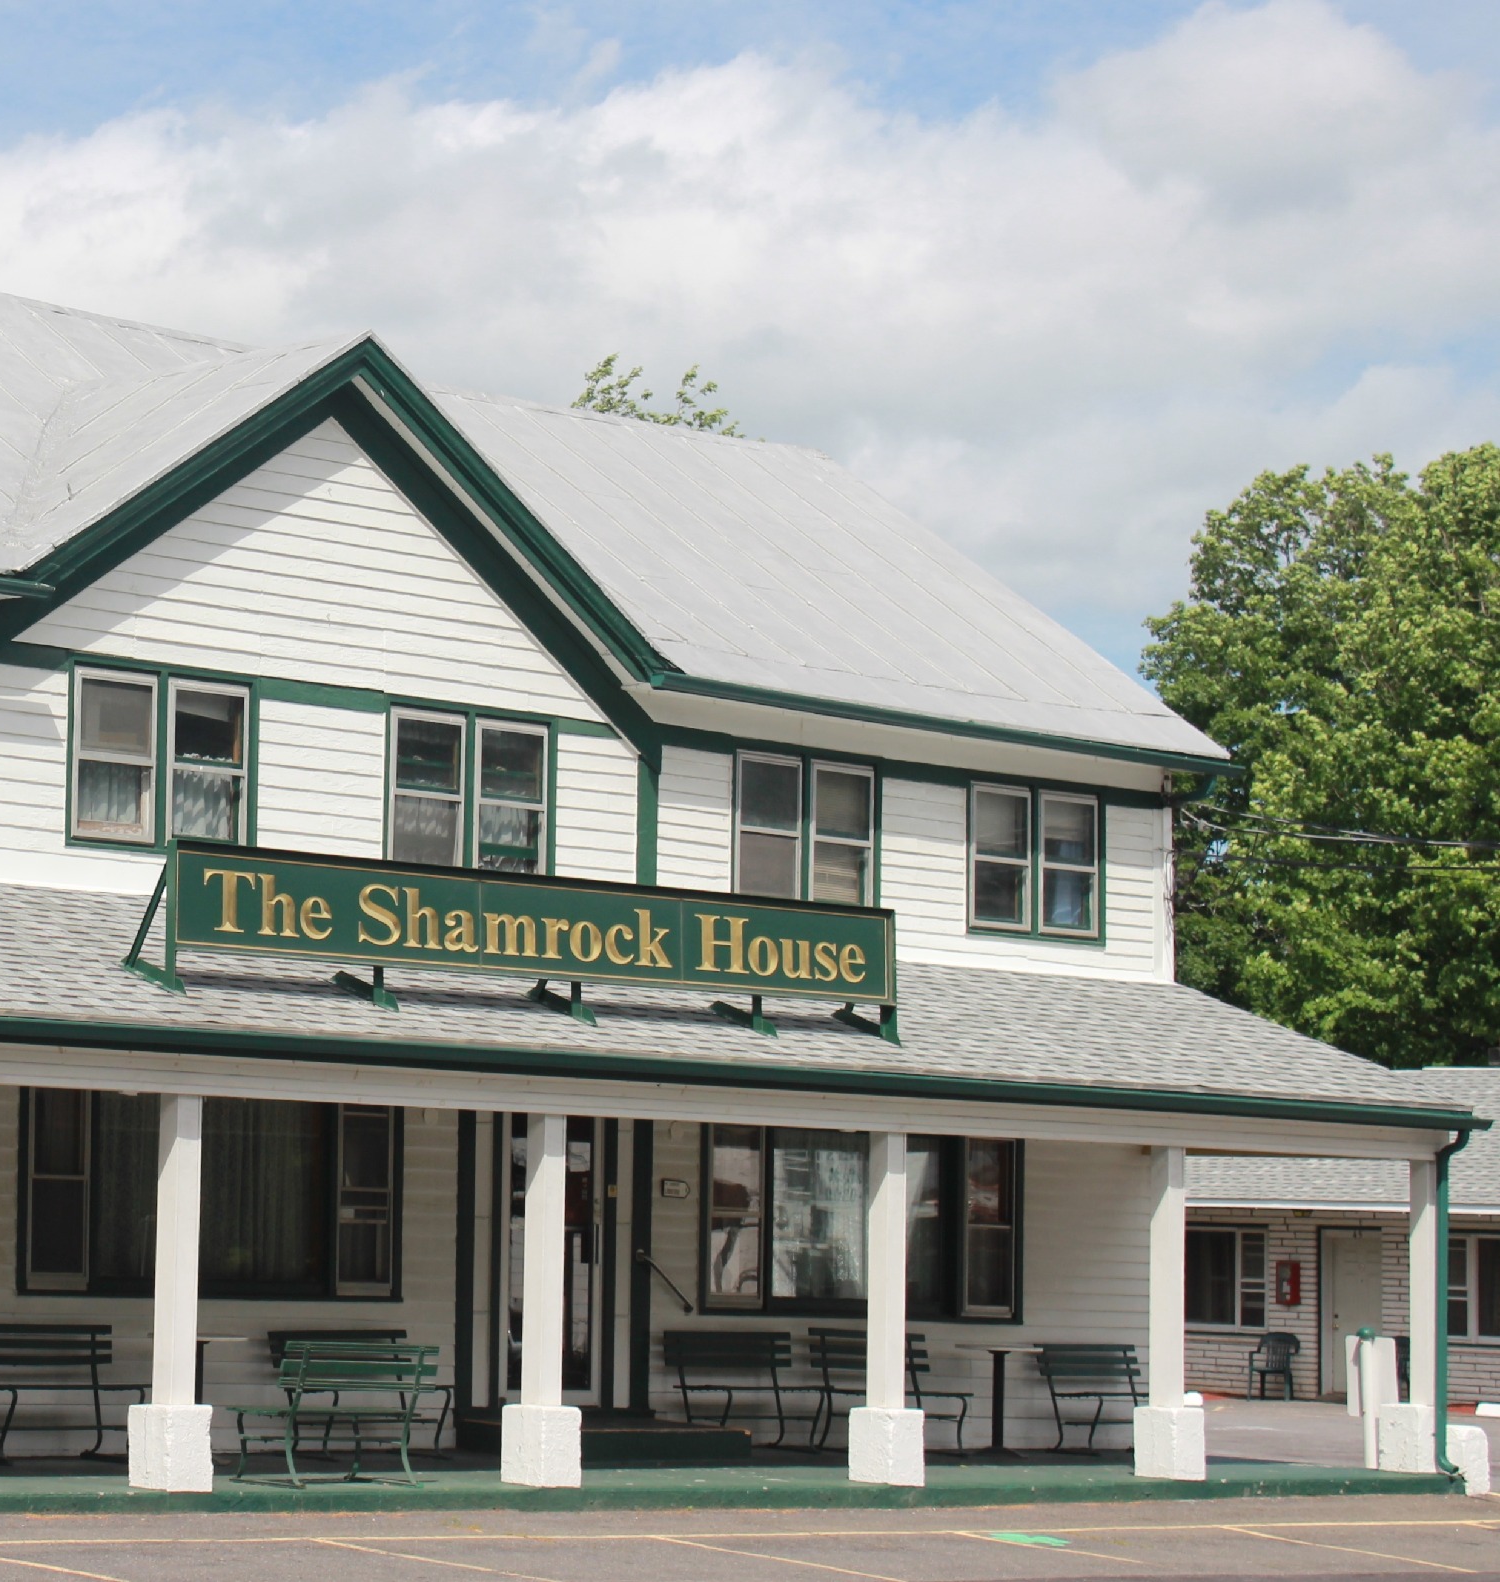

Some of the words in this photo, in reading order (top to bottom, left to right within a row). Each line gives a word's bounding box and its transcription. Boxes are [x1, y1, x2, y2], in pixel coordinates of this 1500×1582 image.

[202, 868, 332, 940] The
[358, 883, 673, 969] Shamrock
[694, 912, 868, 983] House
